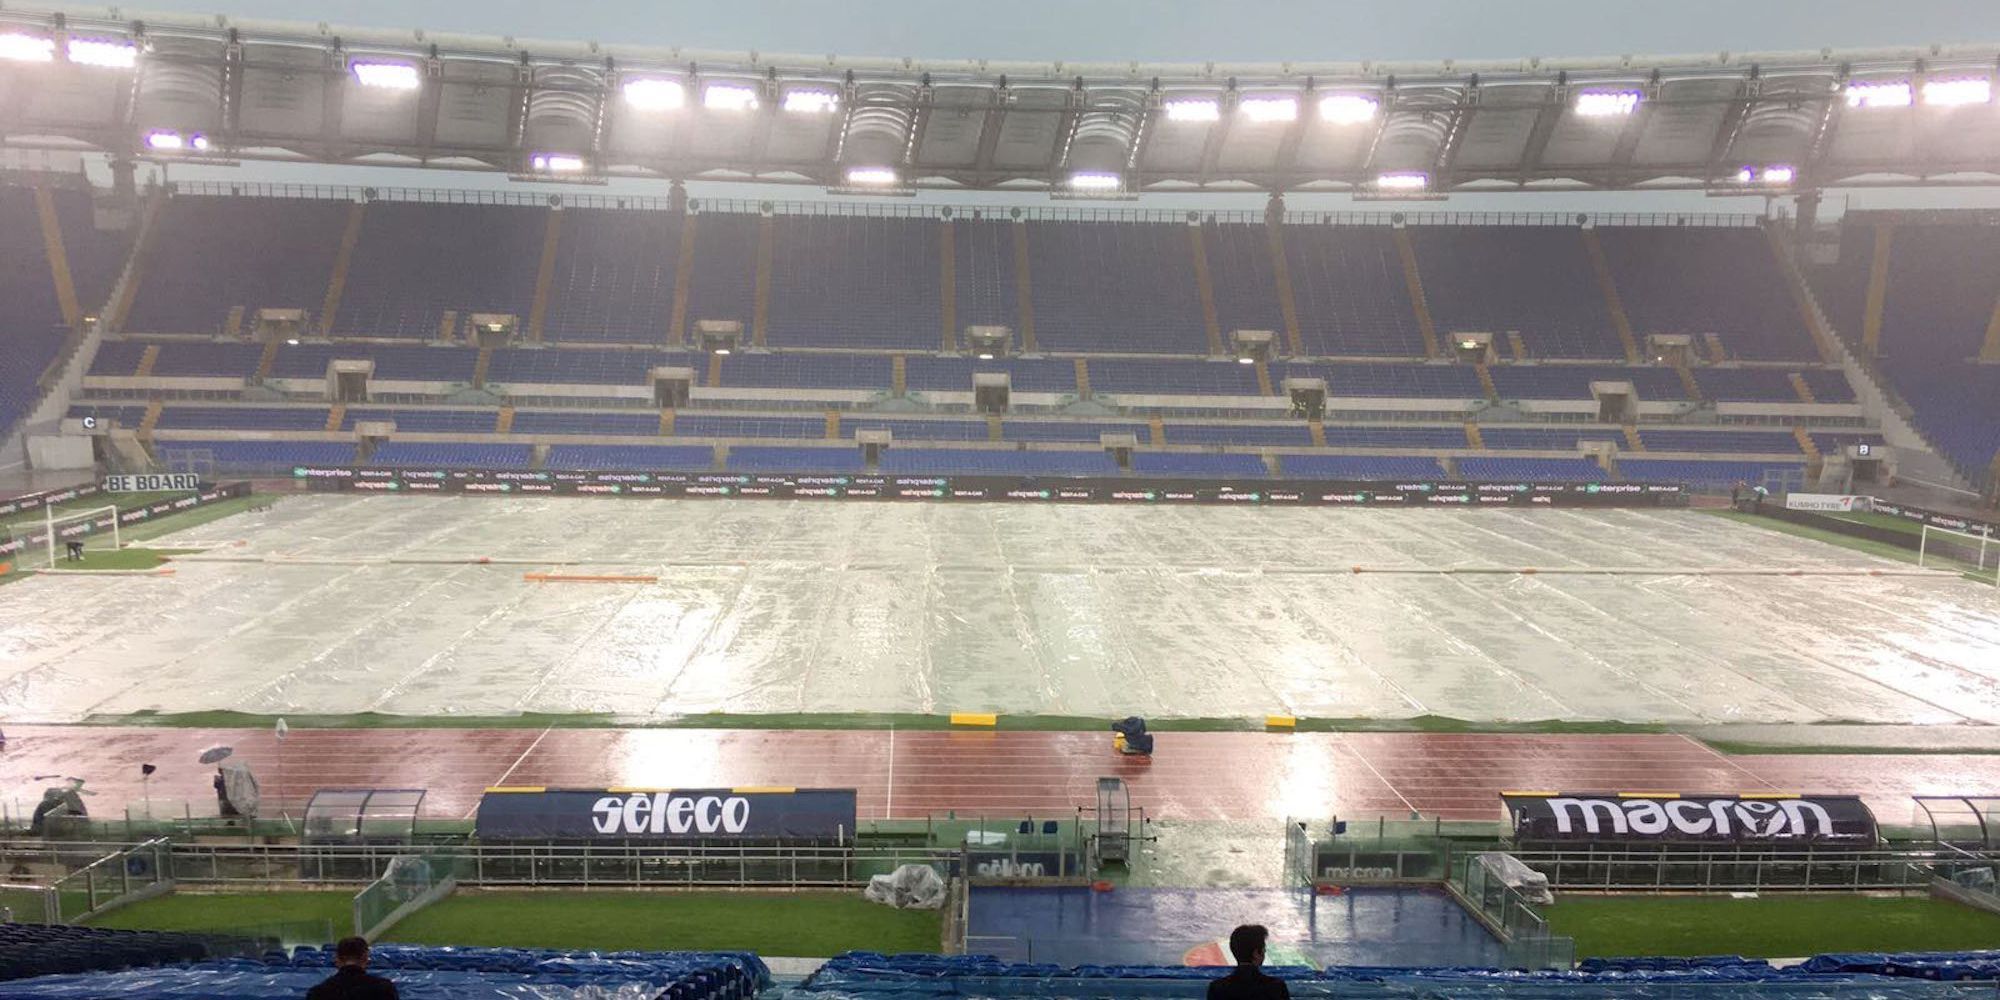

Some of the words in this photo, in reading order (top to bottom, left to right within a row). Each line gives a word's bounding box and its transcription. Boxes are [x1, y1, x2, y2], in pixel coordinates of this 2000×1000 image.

[84, 416, 96, 428] C
[109, 476, 131, 491] BE
[136, 474, 200, 490] BOARD
[1546, 798, 1833, 835] macron
